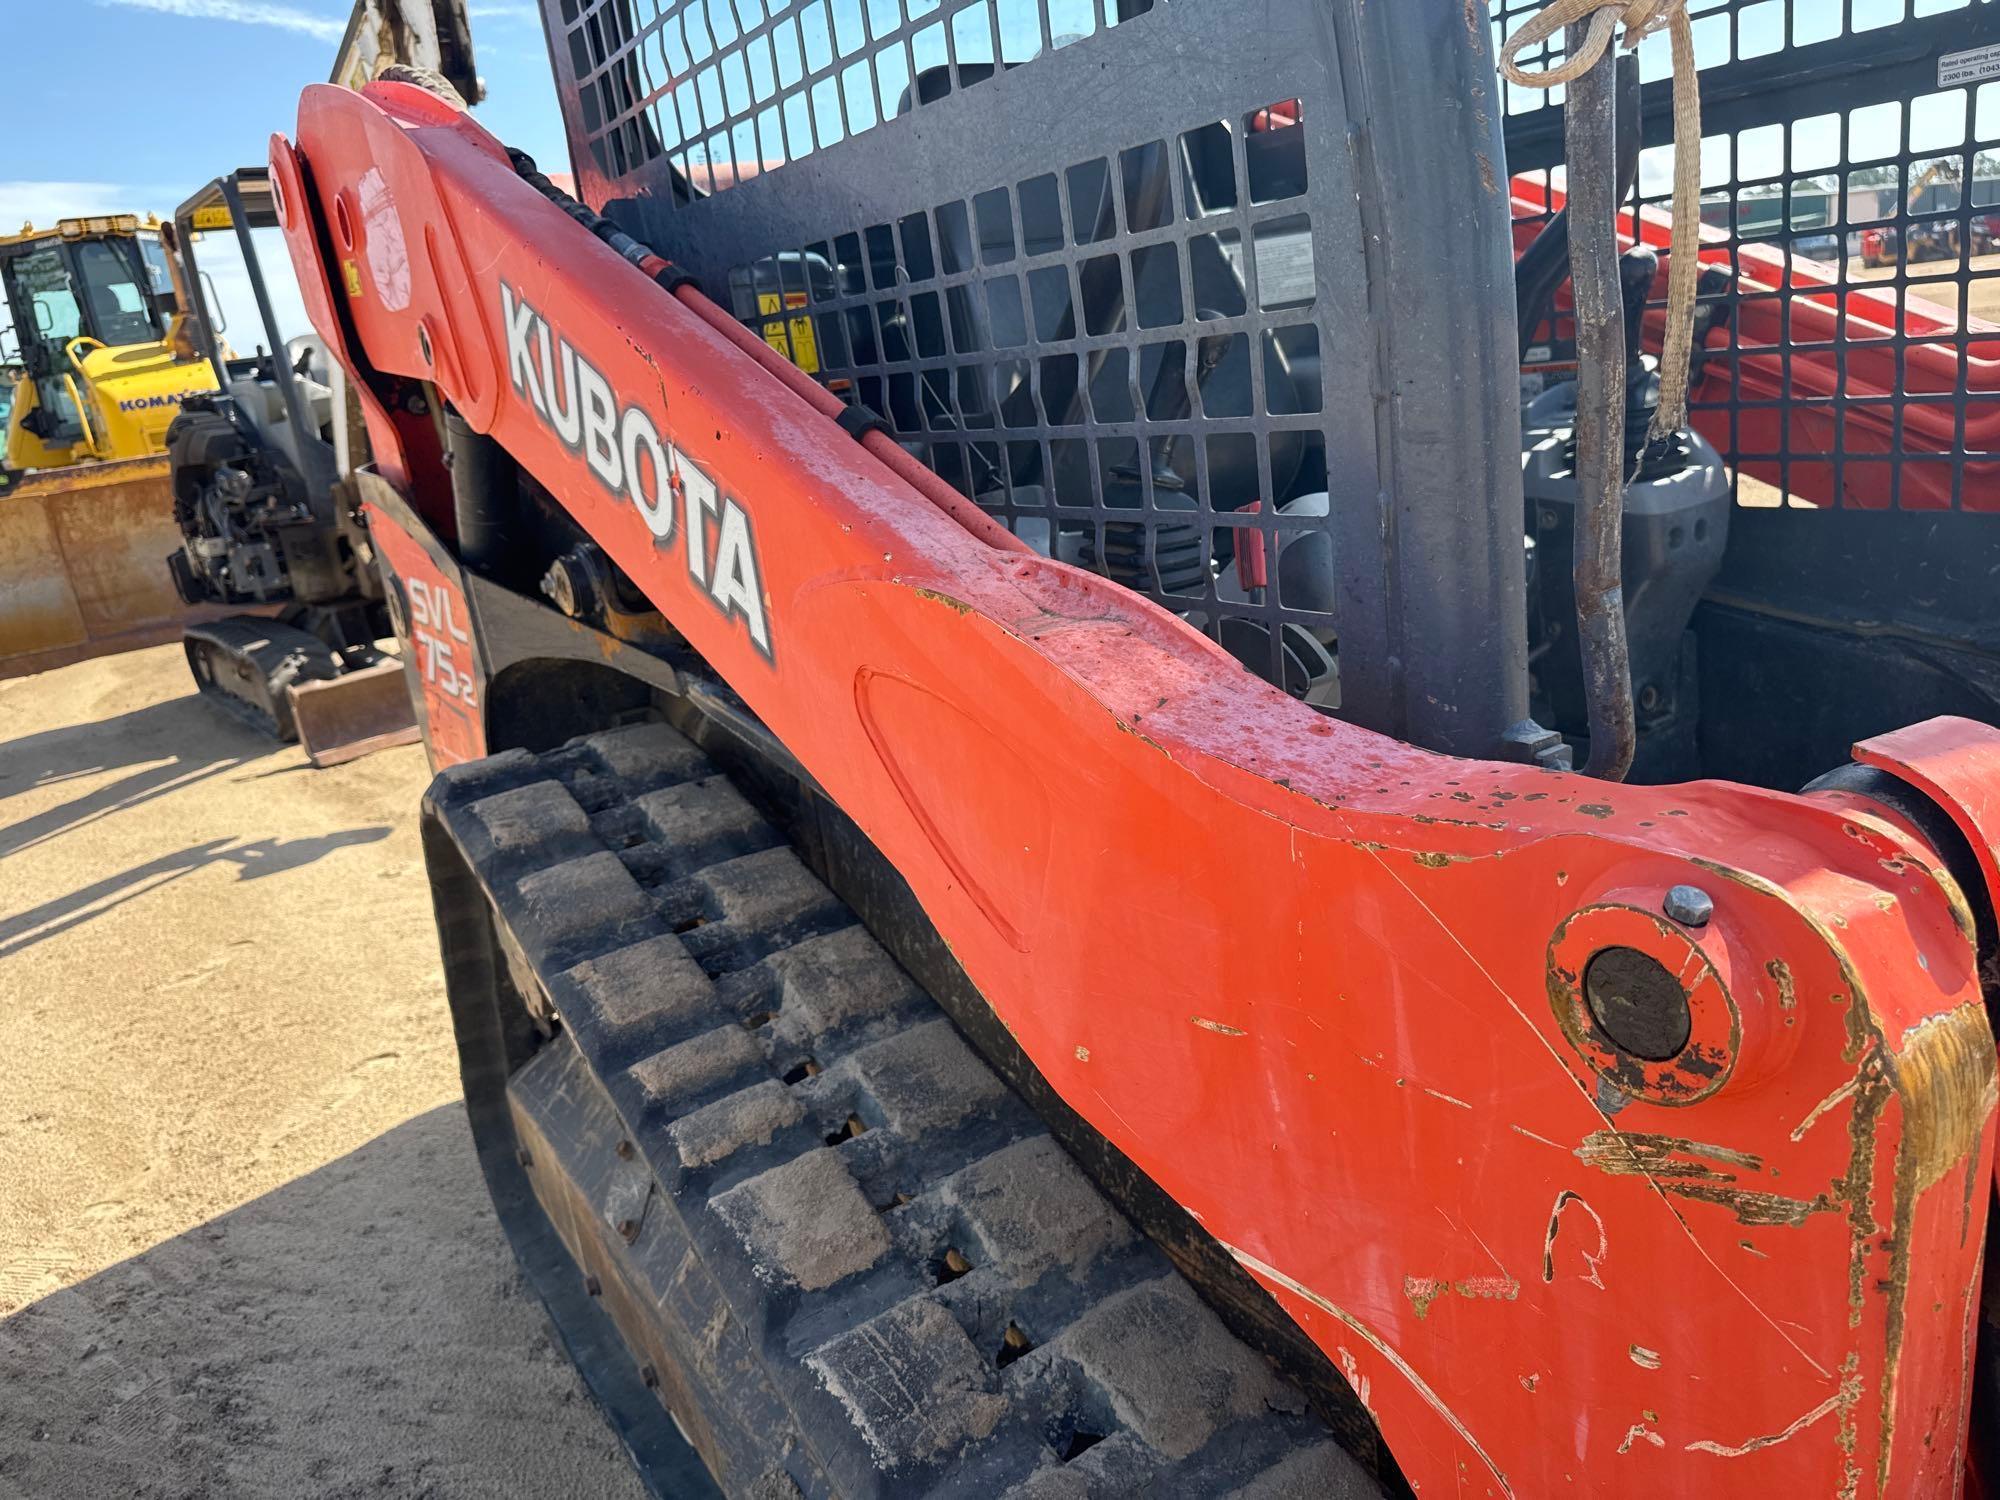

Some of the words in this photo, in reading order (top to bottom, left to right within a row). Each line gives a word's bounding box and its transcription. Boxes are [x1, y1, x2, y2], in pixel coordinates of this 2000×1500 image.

[1941, 60, 1958, 68] Rated
[1959, 53, 1989, 65] operating
[1942, 71, 1960, 82] 2300
[1961, 70, 1975, 78] lbs.
[500, 281, 773, 659] KUBOTA
[409, 577, 468, 644] SVL
